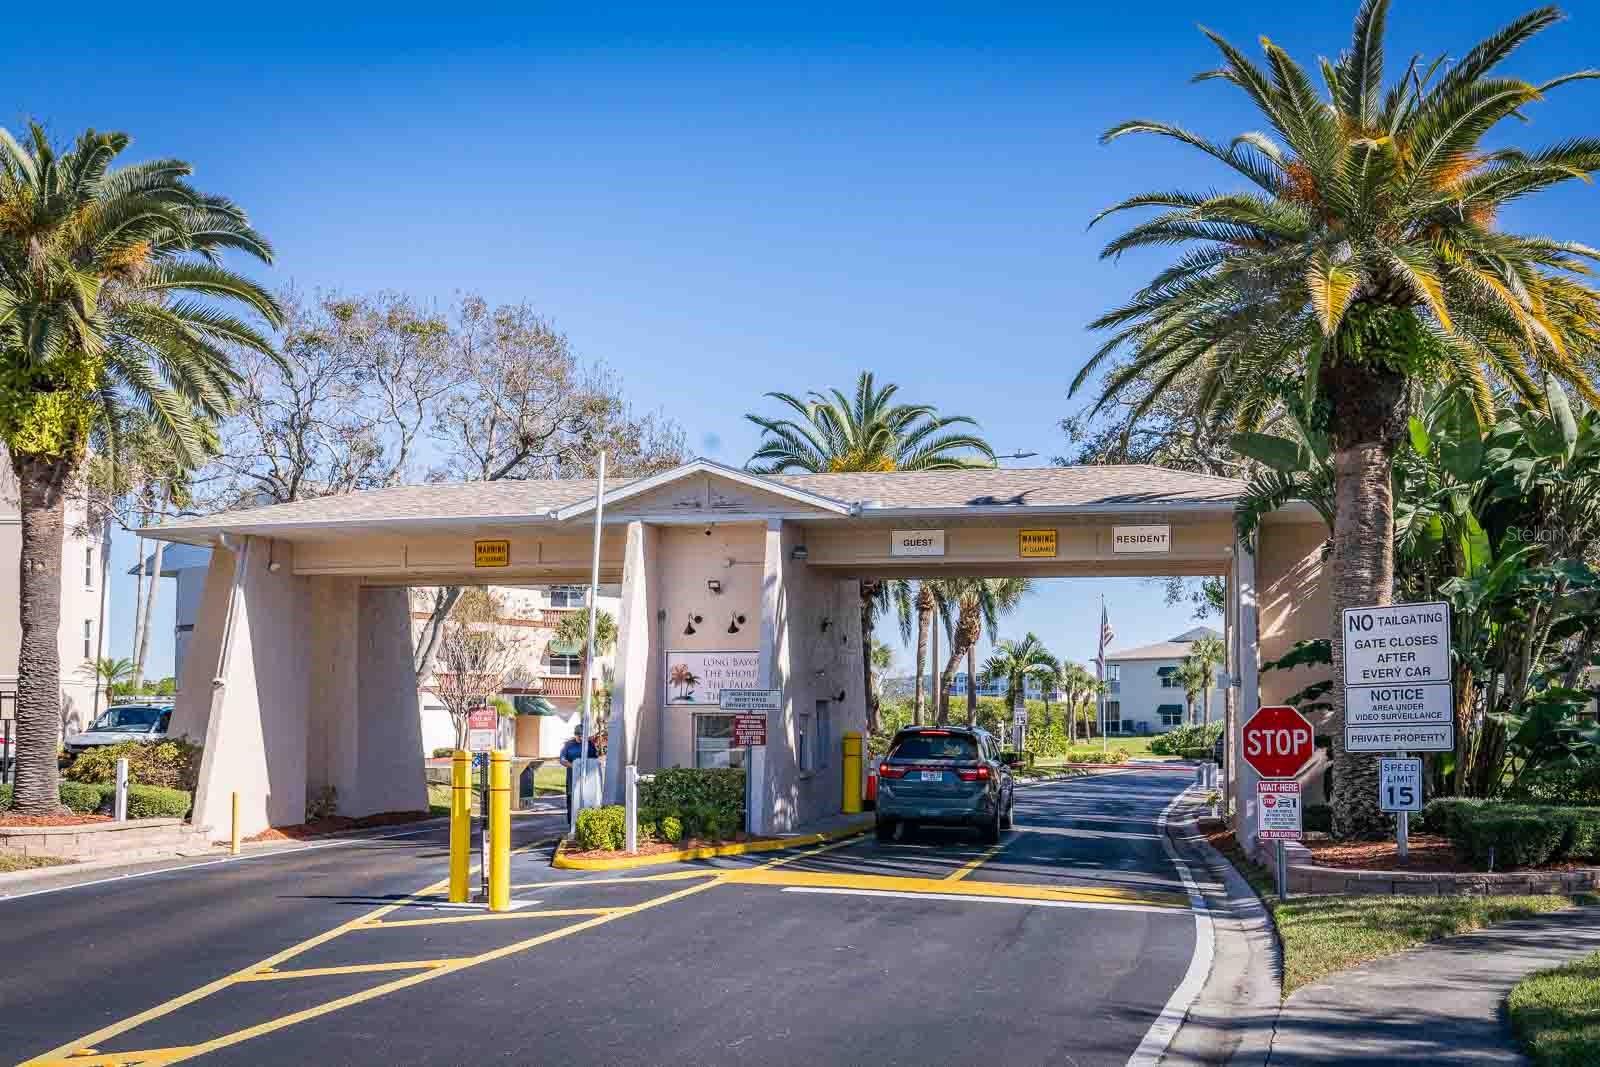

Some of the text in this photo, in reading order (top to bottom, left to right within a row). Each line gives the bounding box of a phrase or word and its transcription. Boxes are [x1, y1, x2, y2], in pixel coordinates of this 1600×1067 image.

[903, 539, 933, 547] GUEST
[1023, 535, 1054, 543] WARNING
[1116, 535, 1167, 544] RESIDENT
[1349, 612, 1443, 632] NO TAILGATING
[1354, 635, 1439, 650] GATE CLOSES
[703, 657, 729, 667] LONG
[1377, 651, 1416, 663] AFTER
[704, 669, 723, 678] THE
[1362, 666, 1431, 679] EVERY CAR
[707, 681, 726, 689] THE
[1370, 688, 1424, 702] NOTICE
[1371, 703, 1424, 712] AREA UNDER
[1355, 711, 1443, 721] VIDEO SURVEILLANCE
[1247, 729, 1308, 756] STOP
[1351, 733, 1447, 743] PRIVATE PROPERTY
[1383, 763, 1417, 772] SPEED
[1387, 775, 1414, 783] LIMIT
[1260, 783, 1298, 792] WAIT HERE
[1387, 786, 1414, 806] 15
